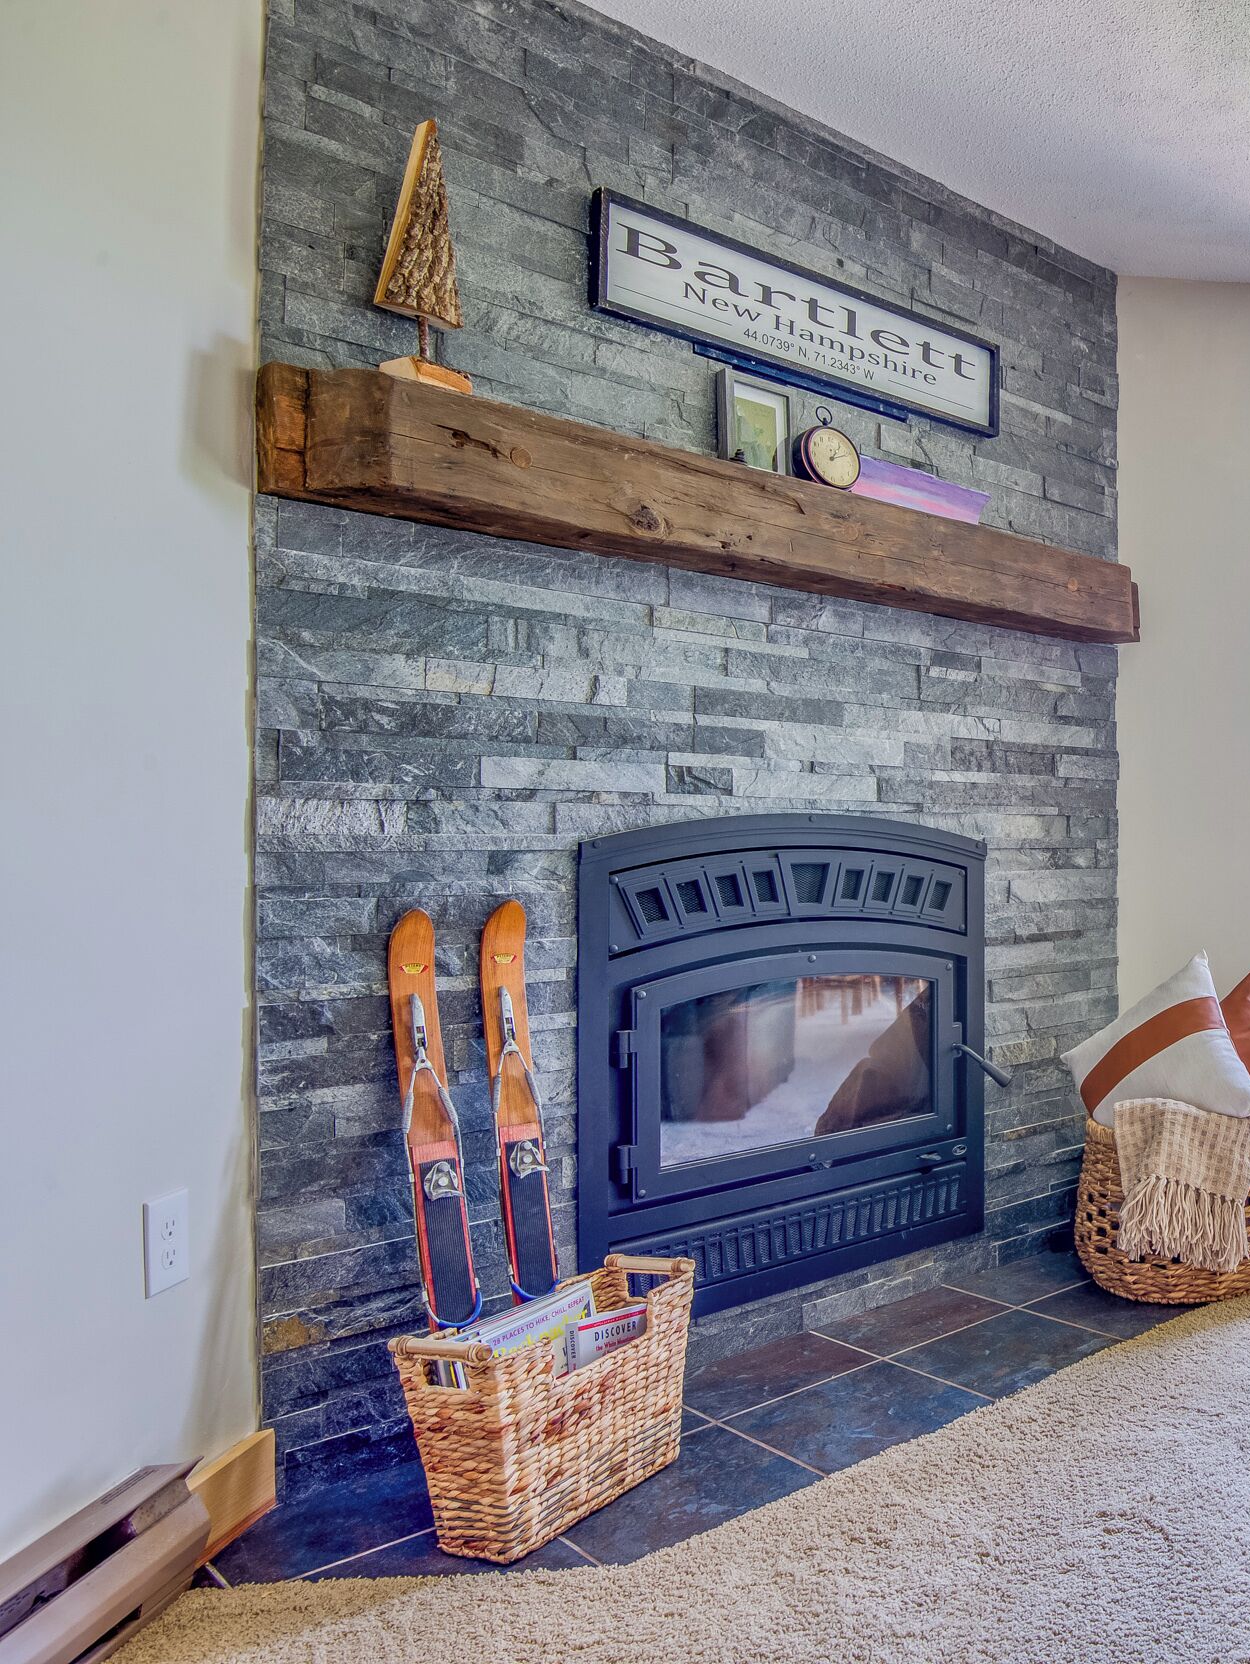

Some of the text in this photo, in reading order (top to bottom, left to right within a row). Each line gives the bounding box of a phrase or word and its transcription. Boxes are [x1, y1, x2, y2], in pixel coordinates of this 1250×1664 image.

[615, 222, 976, 381] Bartlett
[683, 281, 937, 386] New Hampshire
[743, 328, 875, 380] 44.0739° N, 71.2343° W
[502, 1327, 525, 1342] PLACES
[525, 1322, 535, 1331] TO
[567, 1296, 585, 1309] REPEAT
[594, 1320, 637, 1342] DISCOVER
